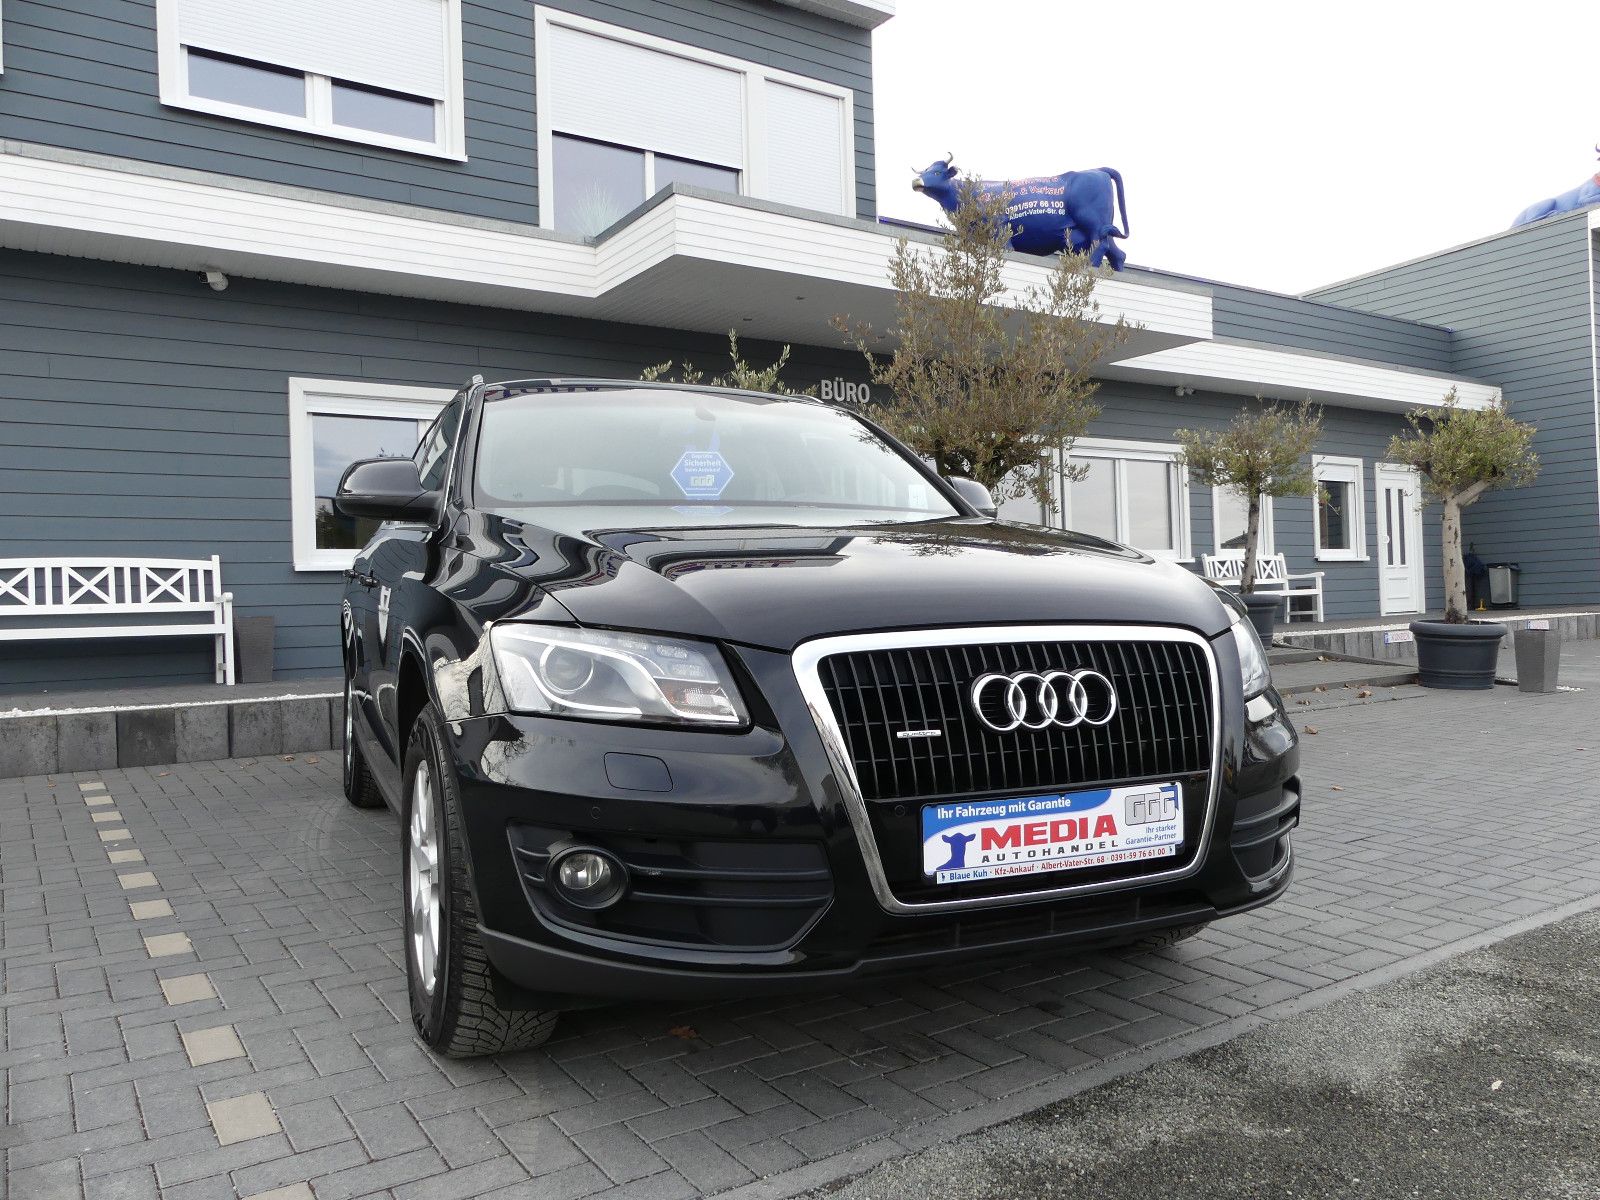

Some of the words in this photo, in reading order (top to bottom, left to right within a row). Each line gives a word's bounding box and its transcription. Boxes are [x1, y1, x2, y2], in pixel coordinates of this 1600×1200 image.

[821, 377, 870, 403] BÜRO
[937, 807, 954, 819] Ihr
[955, 804, 1007, 817] Fahrzeug
[1008, 801, 1027, 813] mit
[1027, 797, 1071, 810] Garantie
[980, 814, 1118, 851] MEDIA
[1125, 832, 1177, 845] Garantie-Partner
[1156, 824, 1177, 833] starker
[949, 871, 971, 881] Blaue
[973, 869, 988, 879] Kuh
[994, 864, 1035, 876] Kfz-Ankauf
[1041, 857, 1094, 870] Albert-Vater-Str.
[1096, 855, 1105, 863] 68
[1110, 851, 1137, 862] 0391-59
[1157, 847, 1166, 855] 00
[981, 840, 1119, 864] AUTOHANDEL
